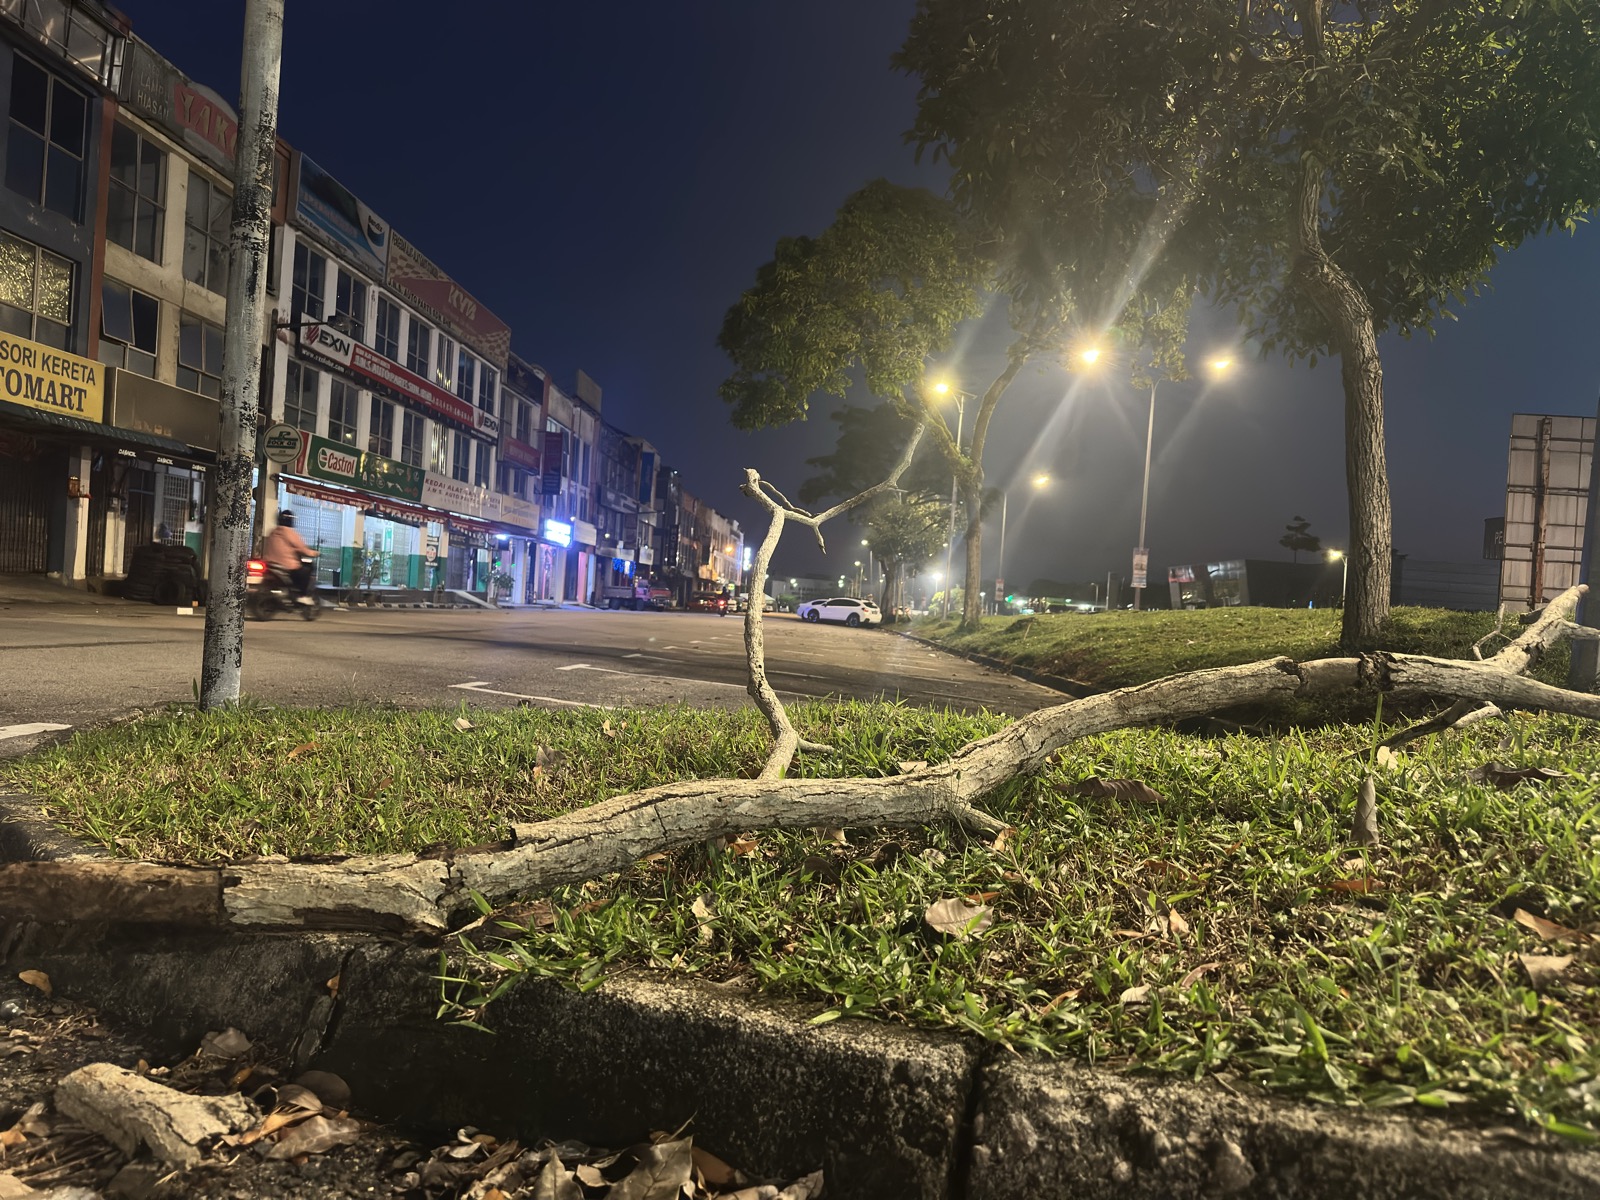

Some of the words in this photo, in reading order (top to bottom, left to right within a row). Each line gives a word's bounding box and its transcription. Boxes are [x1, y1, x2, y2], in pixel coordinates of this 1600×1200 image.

[137, 89, 169, 120] HIASAN
[319, 329, 351, 356] EXN
[41, 352, 96, 386] KERETA
[327, 452, 355, 476] Castrol
[425, 478, 446, 489] KEDAI
[447, 484, 463, 494] ALAT
[445, 491, 460, 499] AUTO
